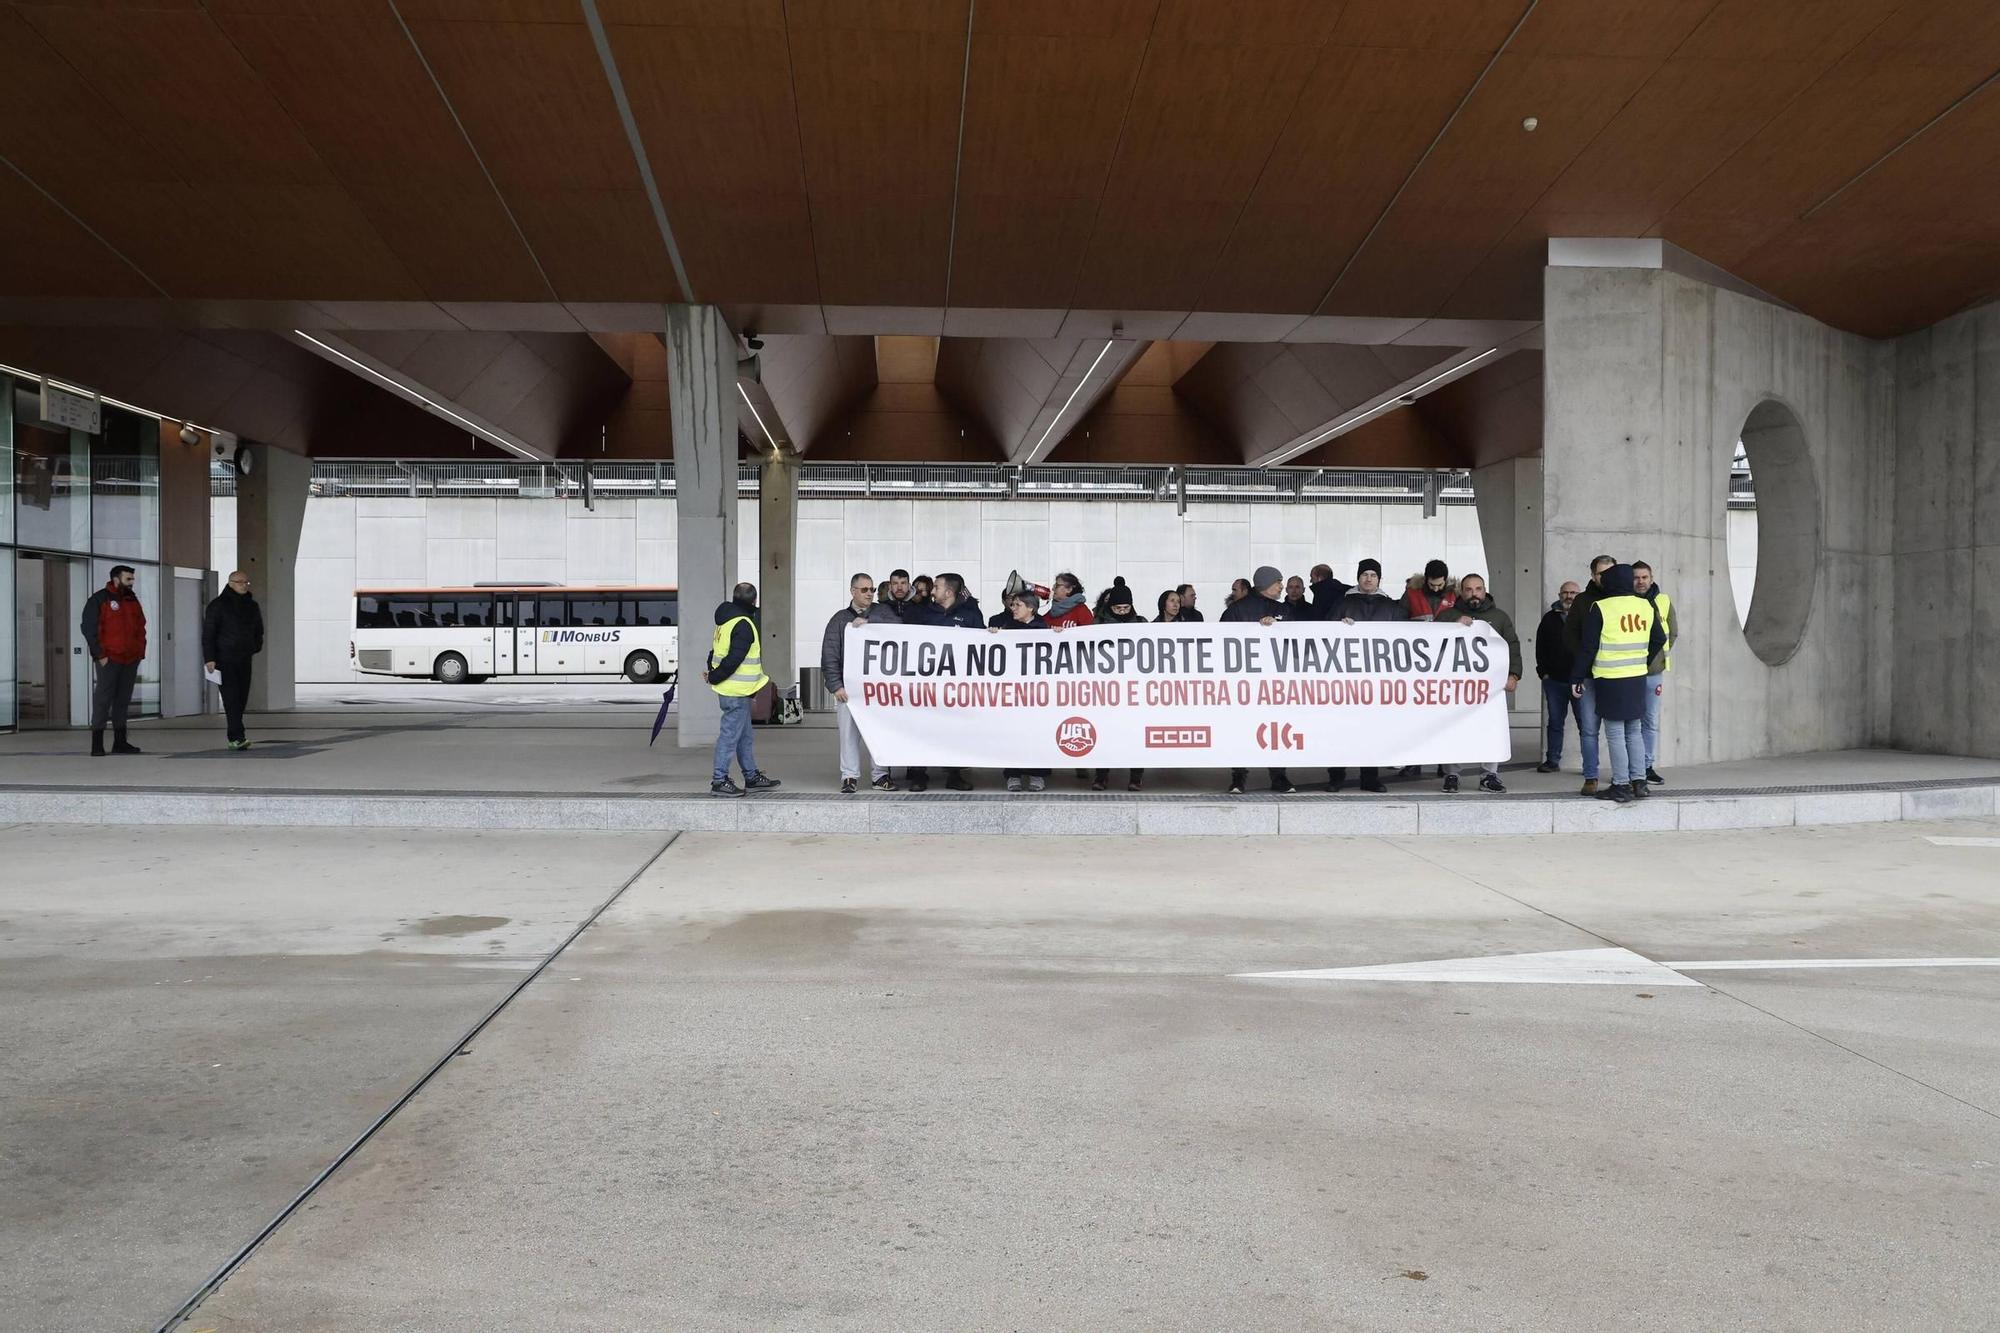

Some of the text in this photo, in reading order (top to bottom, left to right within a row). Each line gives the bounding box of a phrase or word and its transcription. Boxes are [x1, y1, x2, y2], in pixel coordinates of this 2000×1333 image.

[1620, 613, 1647, 633] CIG
[862, 635, 1490, 677] FOLGA NO TRANSPORTE DE VIAXEIROS/AS
[862, 678, 1490, 708] POR UN CONVENIO DIGNO E CONTRA O ABANDONO DO SECTOR
[1060, 723, 1091, 740] UGT
[1148, 729, 1208, 745] CCOO
[1256, 721, 1304, 751] CIG
